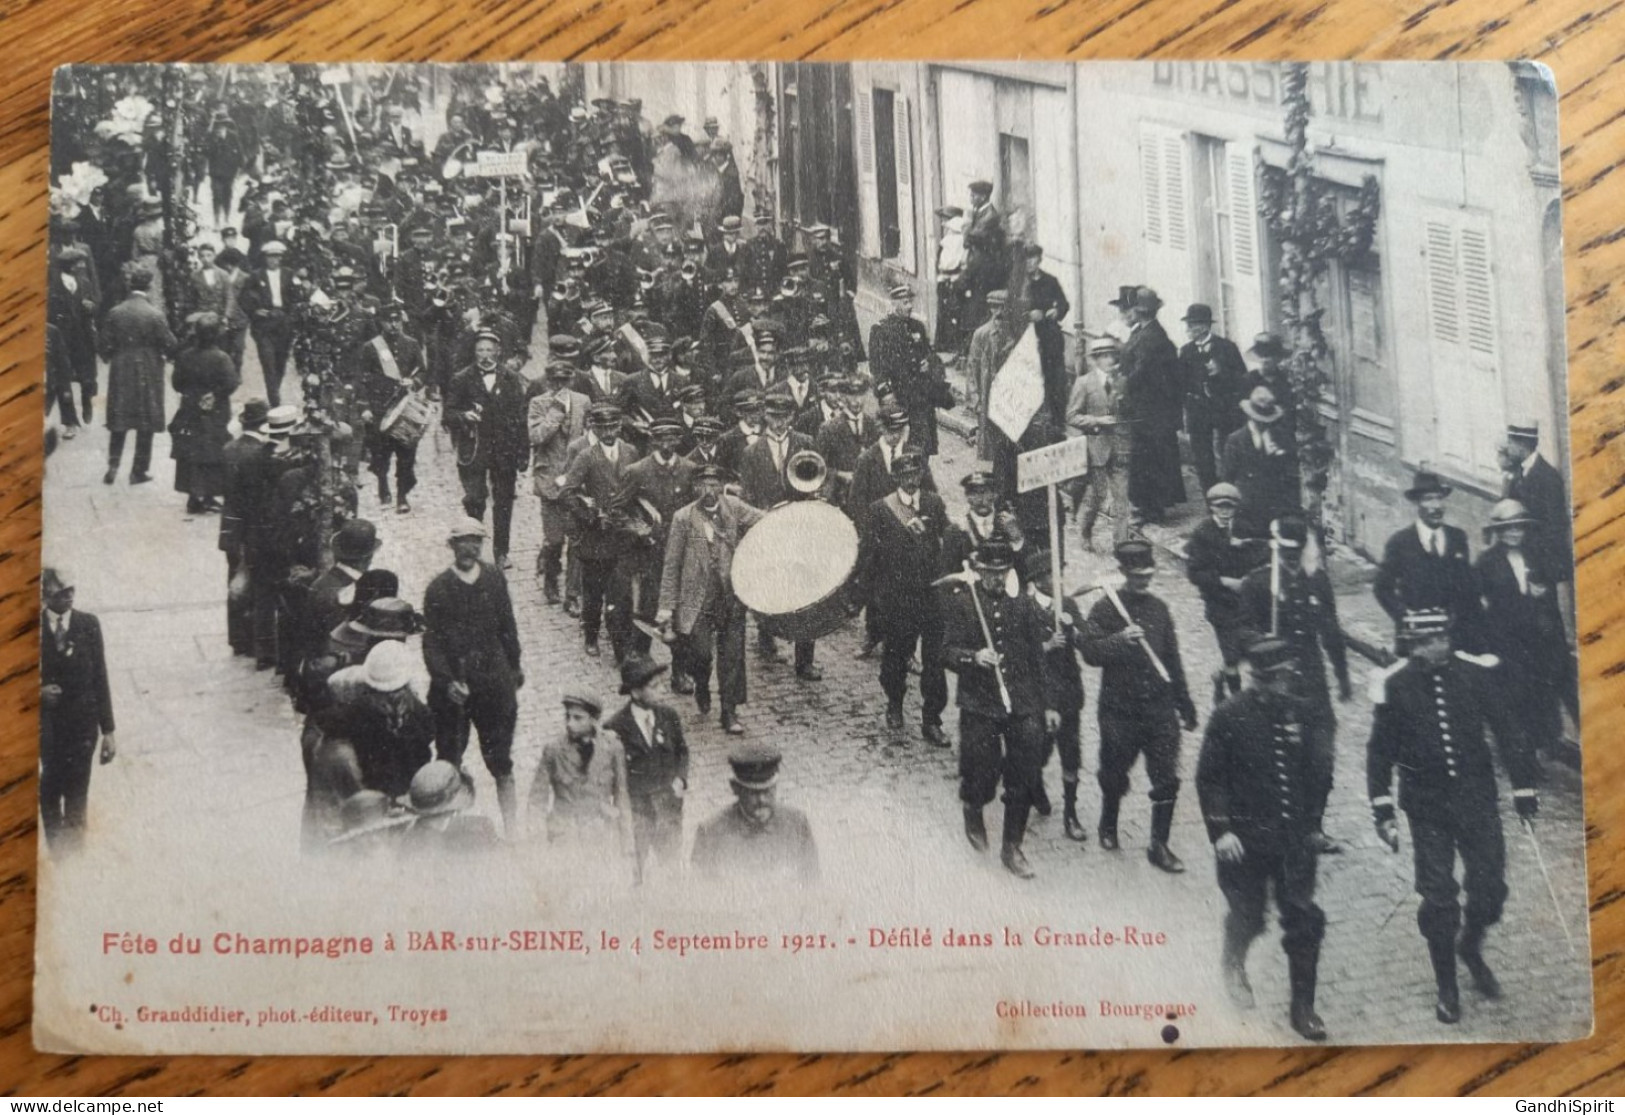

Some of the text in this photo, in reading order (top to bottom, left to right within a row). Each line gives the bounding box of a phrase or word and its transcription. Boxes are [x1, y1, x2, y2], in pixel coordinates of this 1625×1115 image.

[102, 931, 159, 955] Fête
[168, 932, 201, 955] du
[212, 931, 374, 959] Champagne
[385, 933, 396, 952] à
[600, 930, 620, 951] le
[631, 936, 641, 955] 4
[652, 929, 768, 956] Septembre
[781, 933, 836, 954] 1921.
[868, 927, 932, 949] Défilé
[942, 928, 993, 948] dans
[1004, 926, 1022, 947] la
[1033, 926, 1167, 947] Grande-Rue
[99, 1004, 448, 1027] Ch. Granddidier, phot.-éditeur, Troyes
[995, 1000, 1197, 1020] Collection Bourgogne
